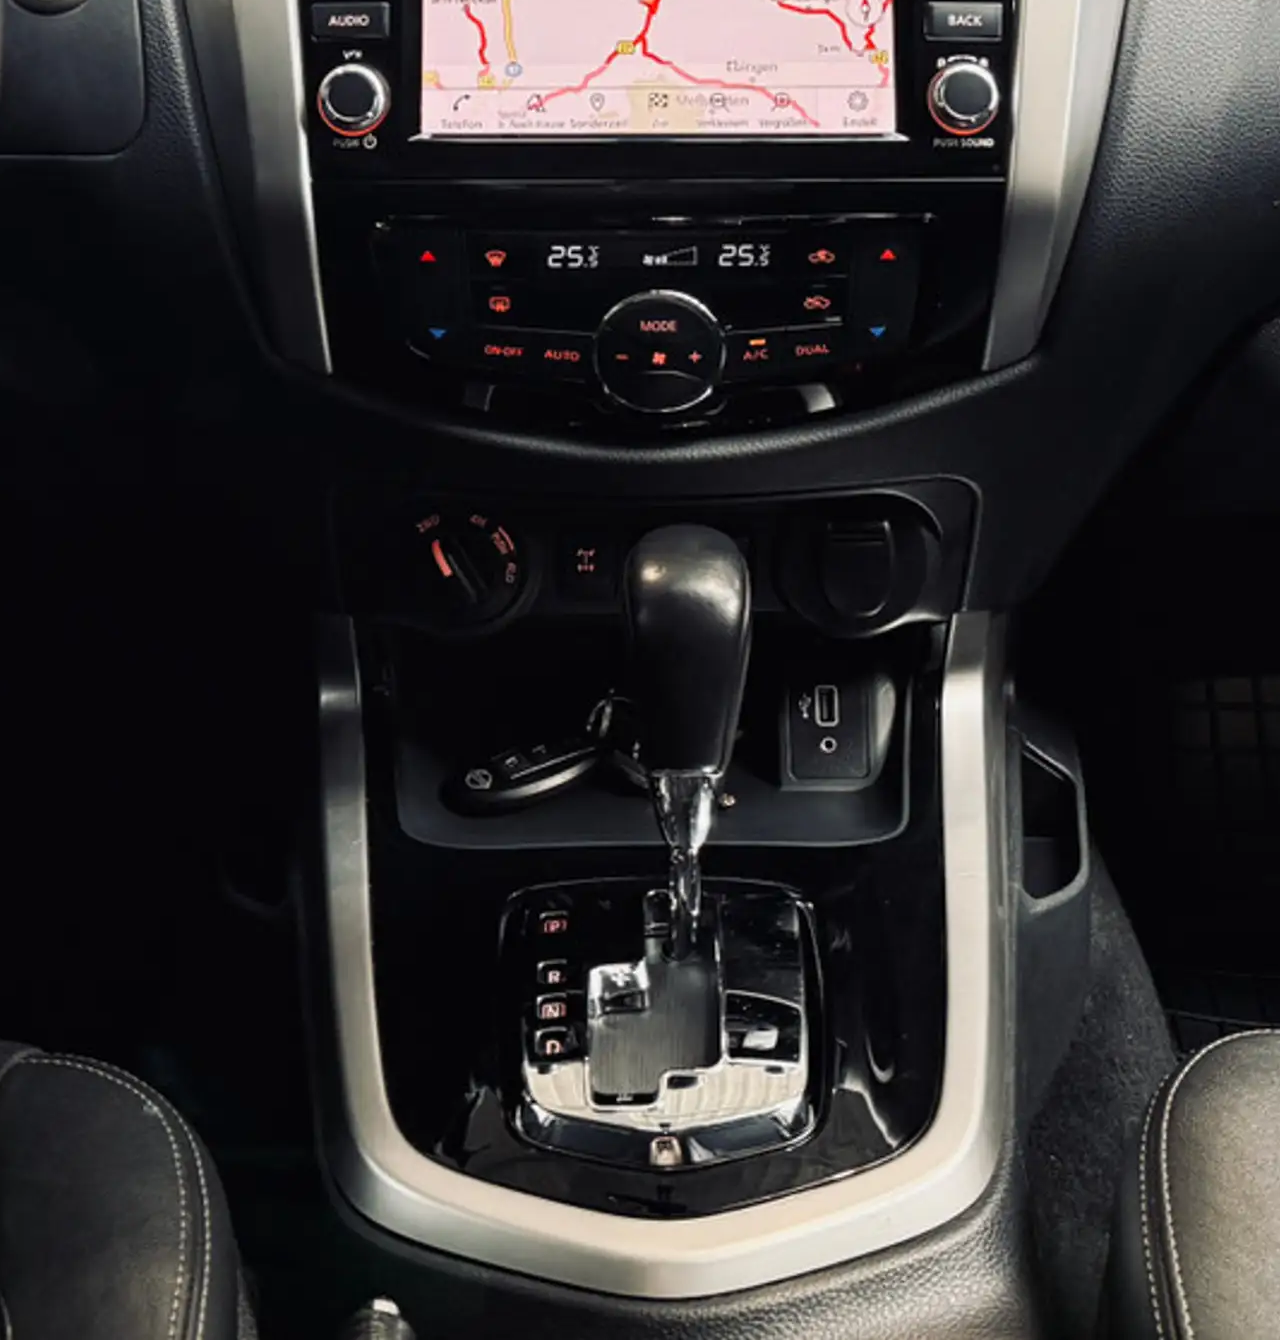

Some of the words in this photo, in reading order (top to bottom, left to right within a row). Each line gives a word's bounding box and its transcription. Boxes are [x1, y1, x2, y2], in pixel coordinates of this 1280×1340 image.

[328, 15, 371, 27] AUDIO
[947, 15, 983, 27] BACK
[960, 137, 995, 149] SOUND
[640, 320, 677, 333] MODE
[544, 349, 581, 362] AUTO
[743, 349, 768, 361] A/C
[795, 344, 830, 357] DUAL
[548, 970, 561, 983] R
[546, 1040, 561, 1054] D
